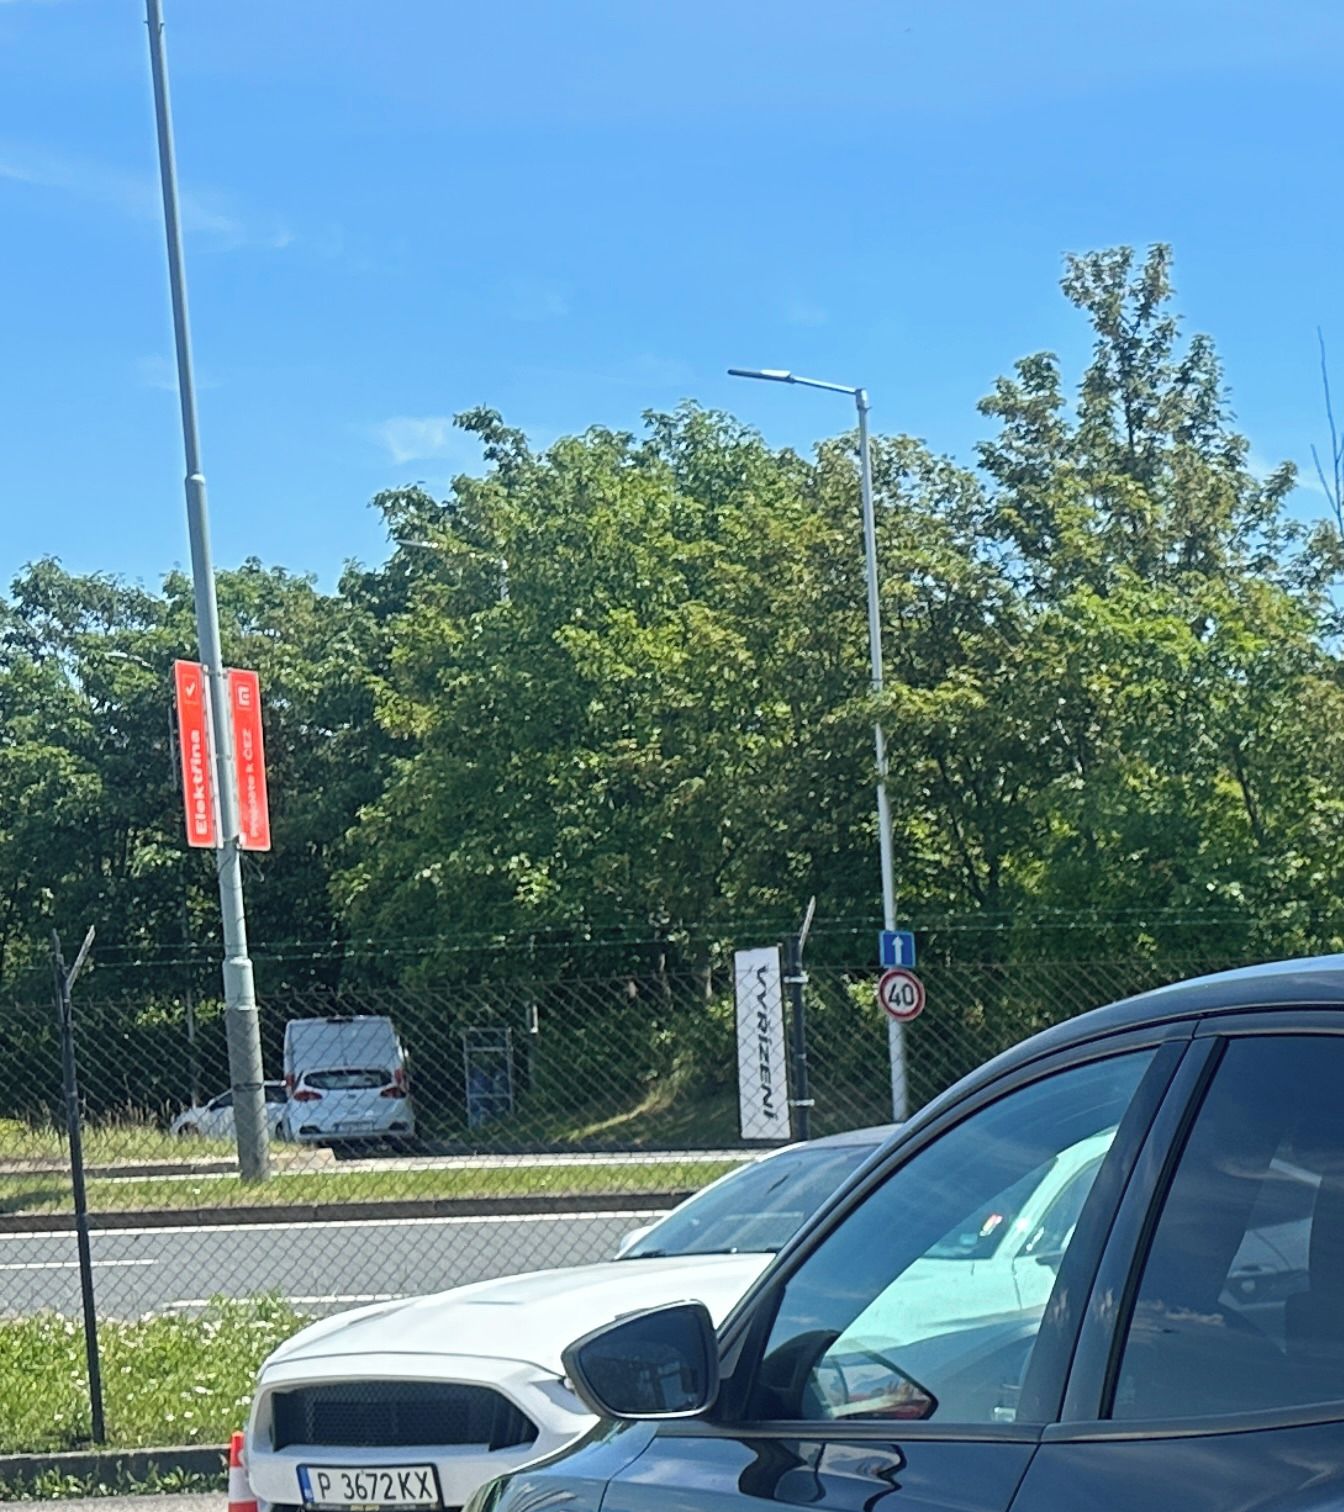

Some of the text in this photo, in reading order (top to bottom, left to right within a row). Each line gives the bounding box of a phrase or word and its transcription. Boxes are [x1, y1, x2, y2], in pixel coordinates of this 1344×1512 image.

[190, 729, 208, 835] Elektřina
[888, 983, 915, 1007] 40
[317, 1472, 331, 1499] P
